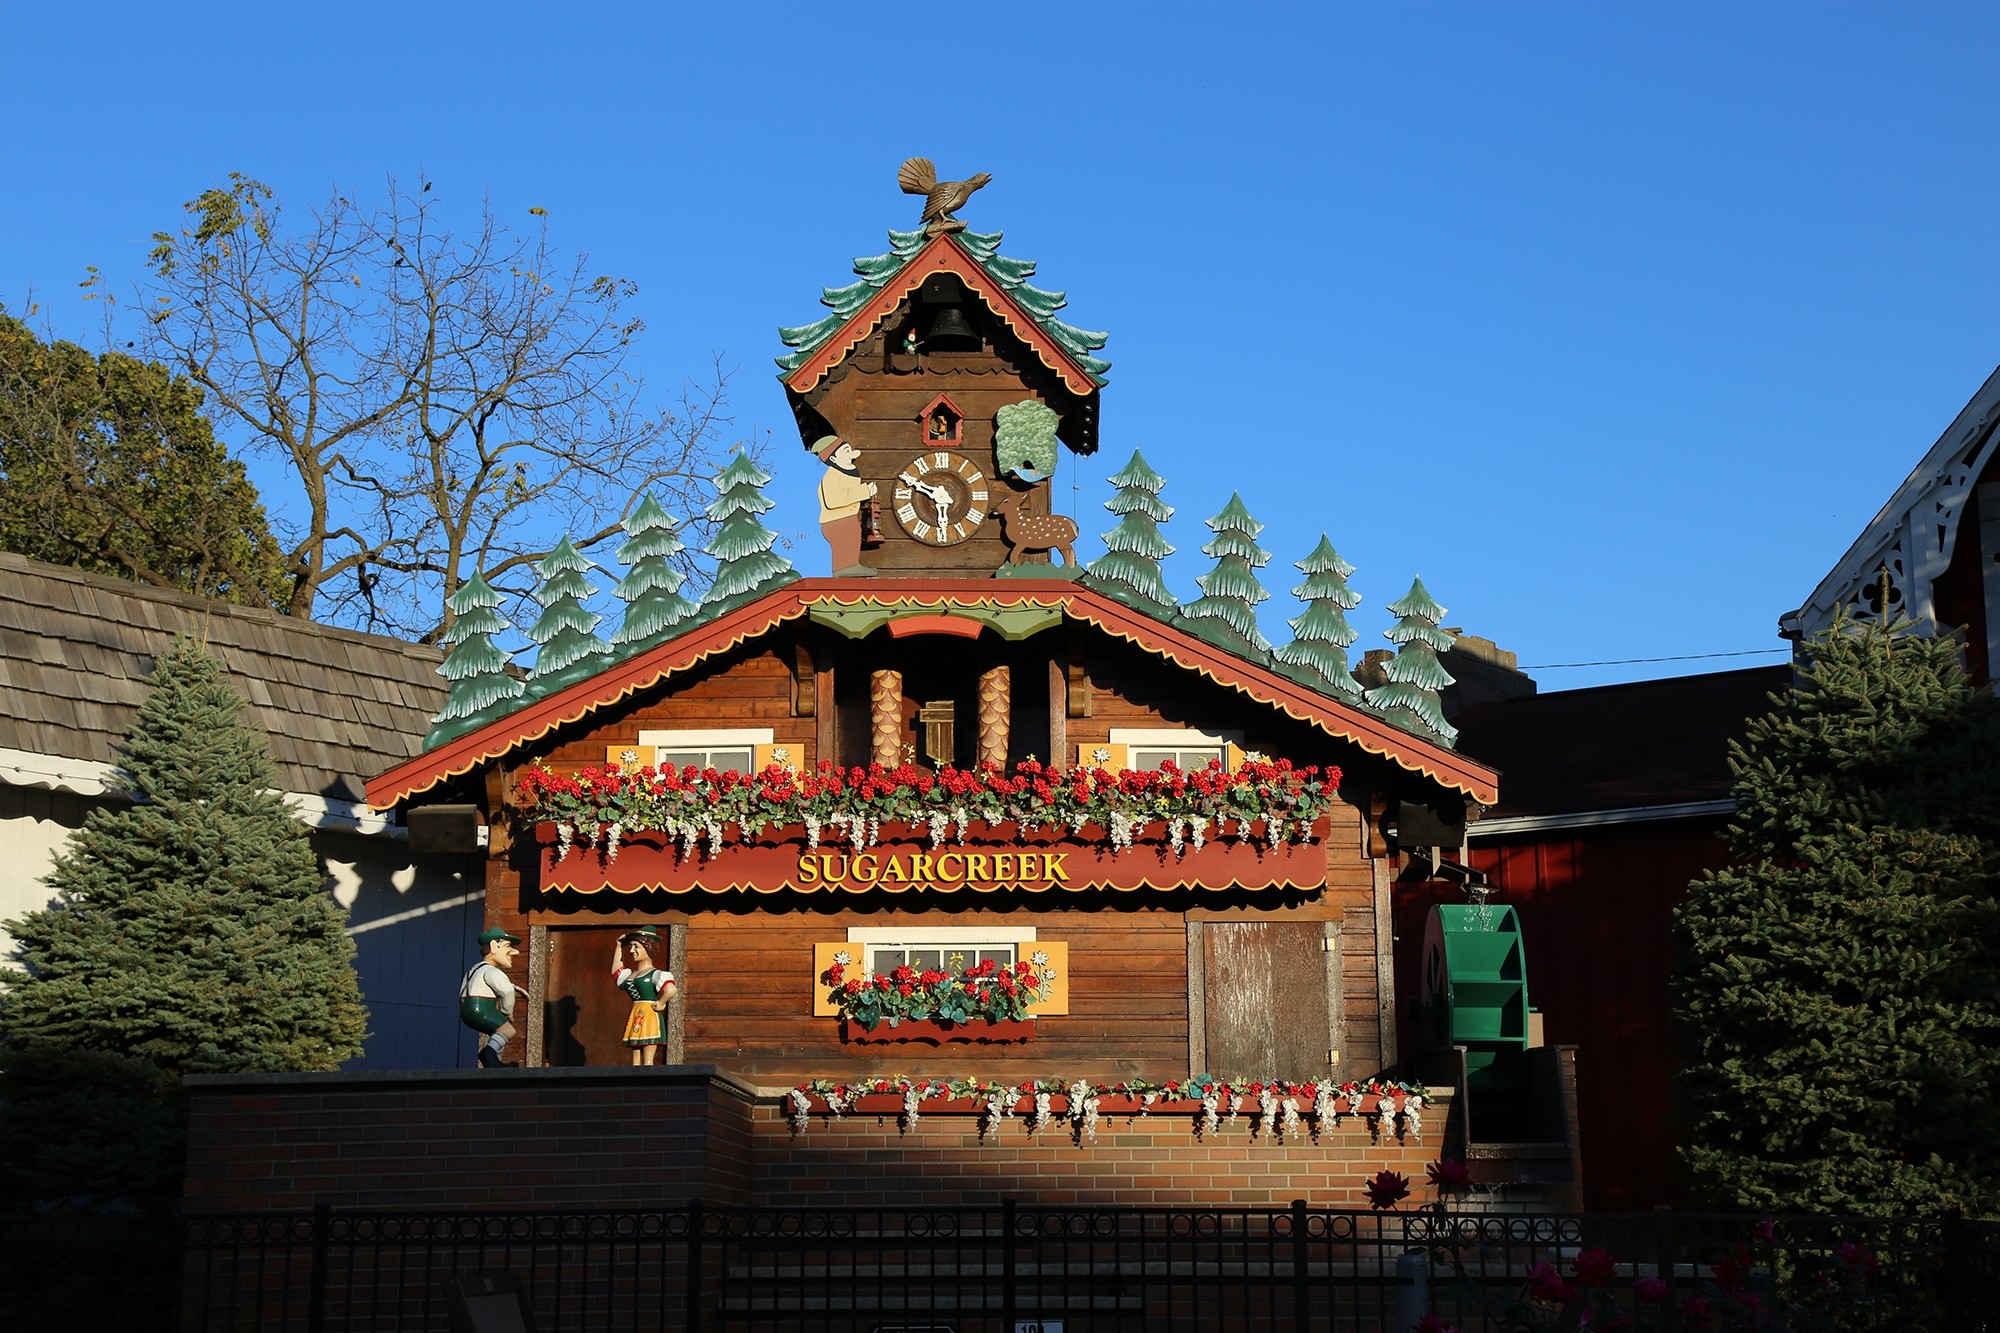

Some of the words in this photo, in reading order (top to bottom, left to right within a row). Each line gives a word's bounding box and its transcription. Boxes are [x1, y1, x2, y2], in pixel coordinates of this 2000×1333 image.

[934, 452, 949, 469] XII
[972, 491, 989, 501] III
[799, 853, 1070, 883] SUGARCREEK
